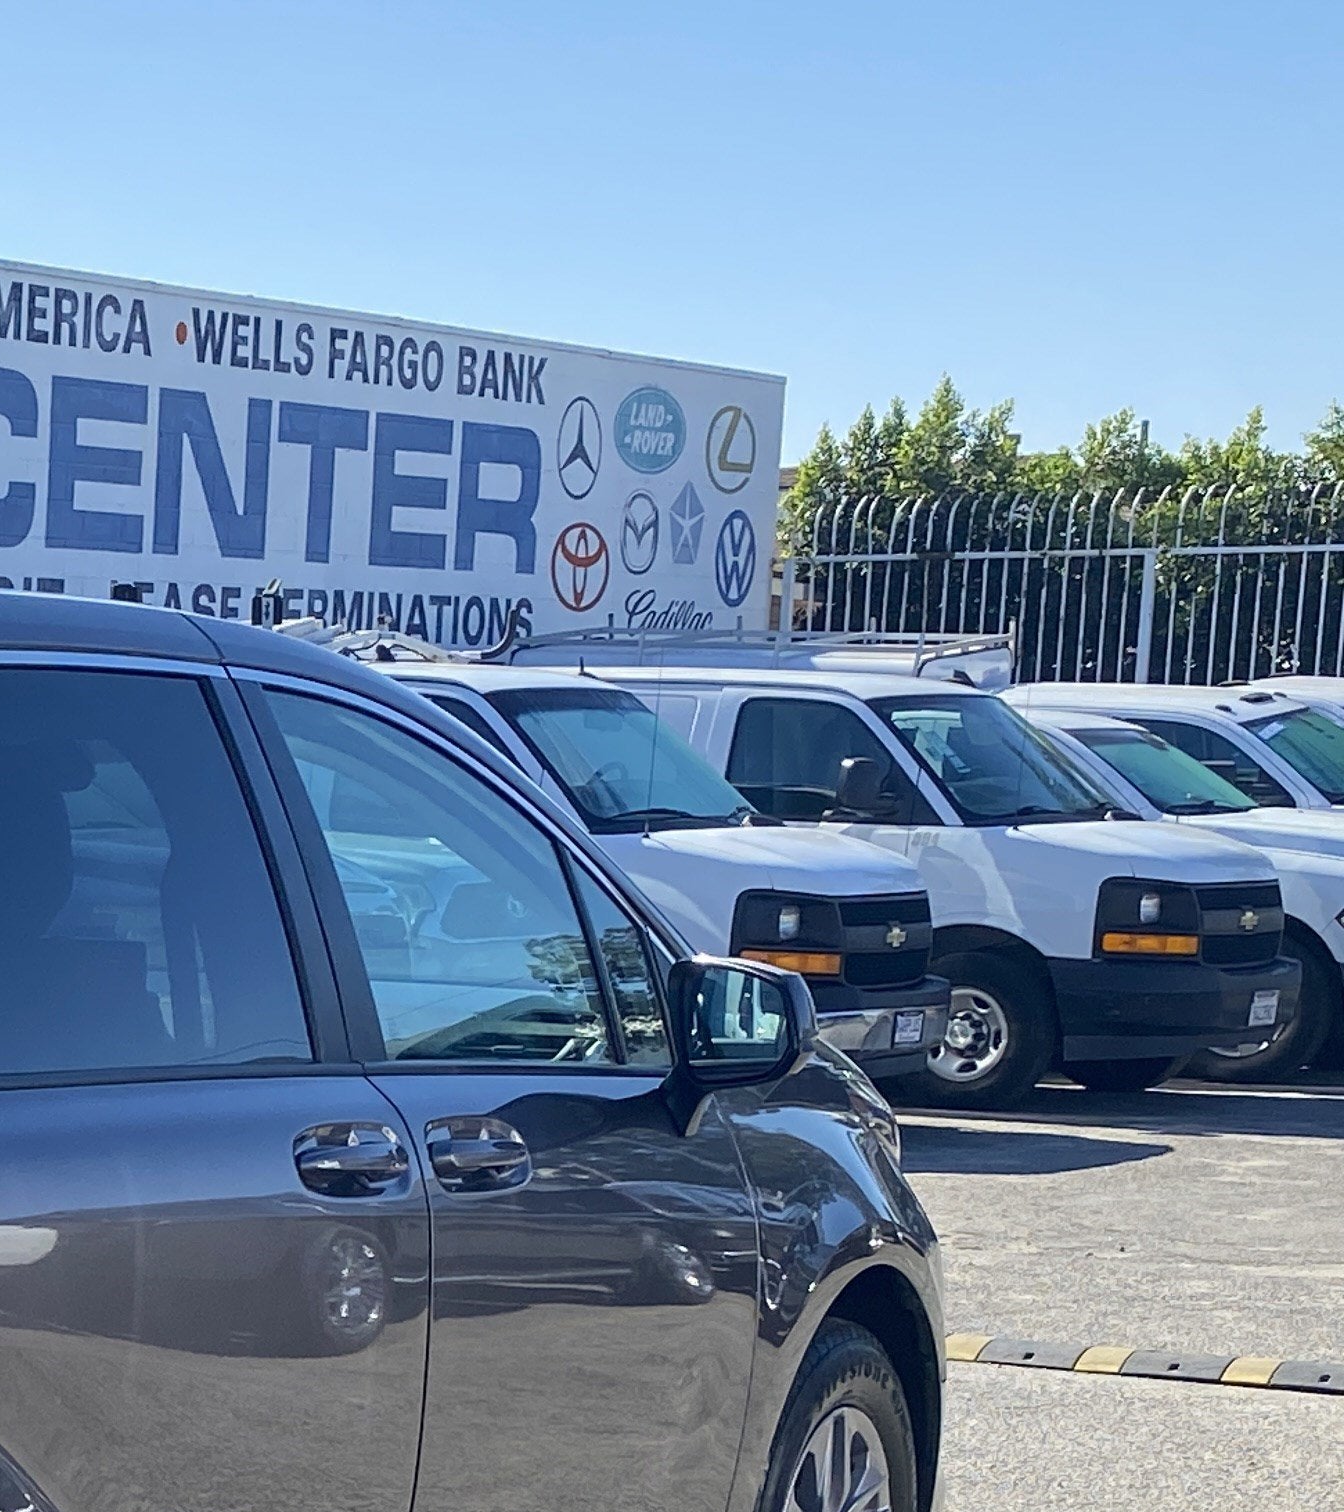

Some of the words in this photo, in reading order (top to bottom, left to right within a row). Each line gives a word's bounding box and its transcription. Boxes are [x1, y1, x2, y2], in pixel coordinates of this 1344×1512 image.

[190, 306, 315, 378] WELLS
[327, 326, 444, 393] FARGO
[456, 346, 549, 405] BANK
[629, 401, 666, 427] LAND
[630, 431, 676, 457] ROVER
[110, 579, 242, 619] ASE
[256, 586, 534, 648] ERMINATIONS
[624, 588, 714, 631] Cadillac
